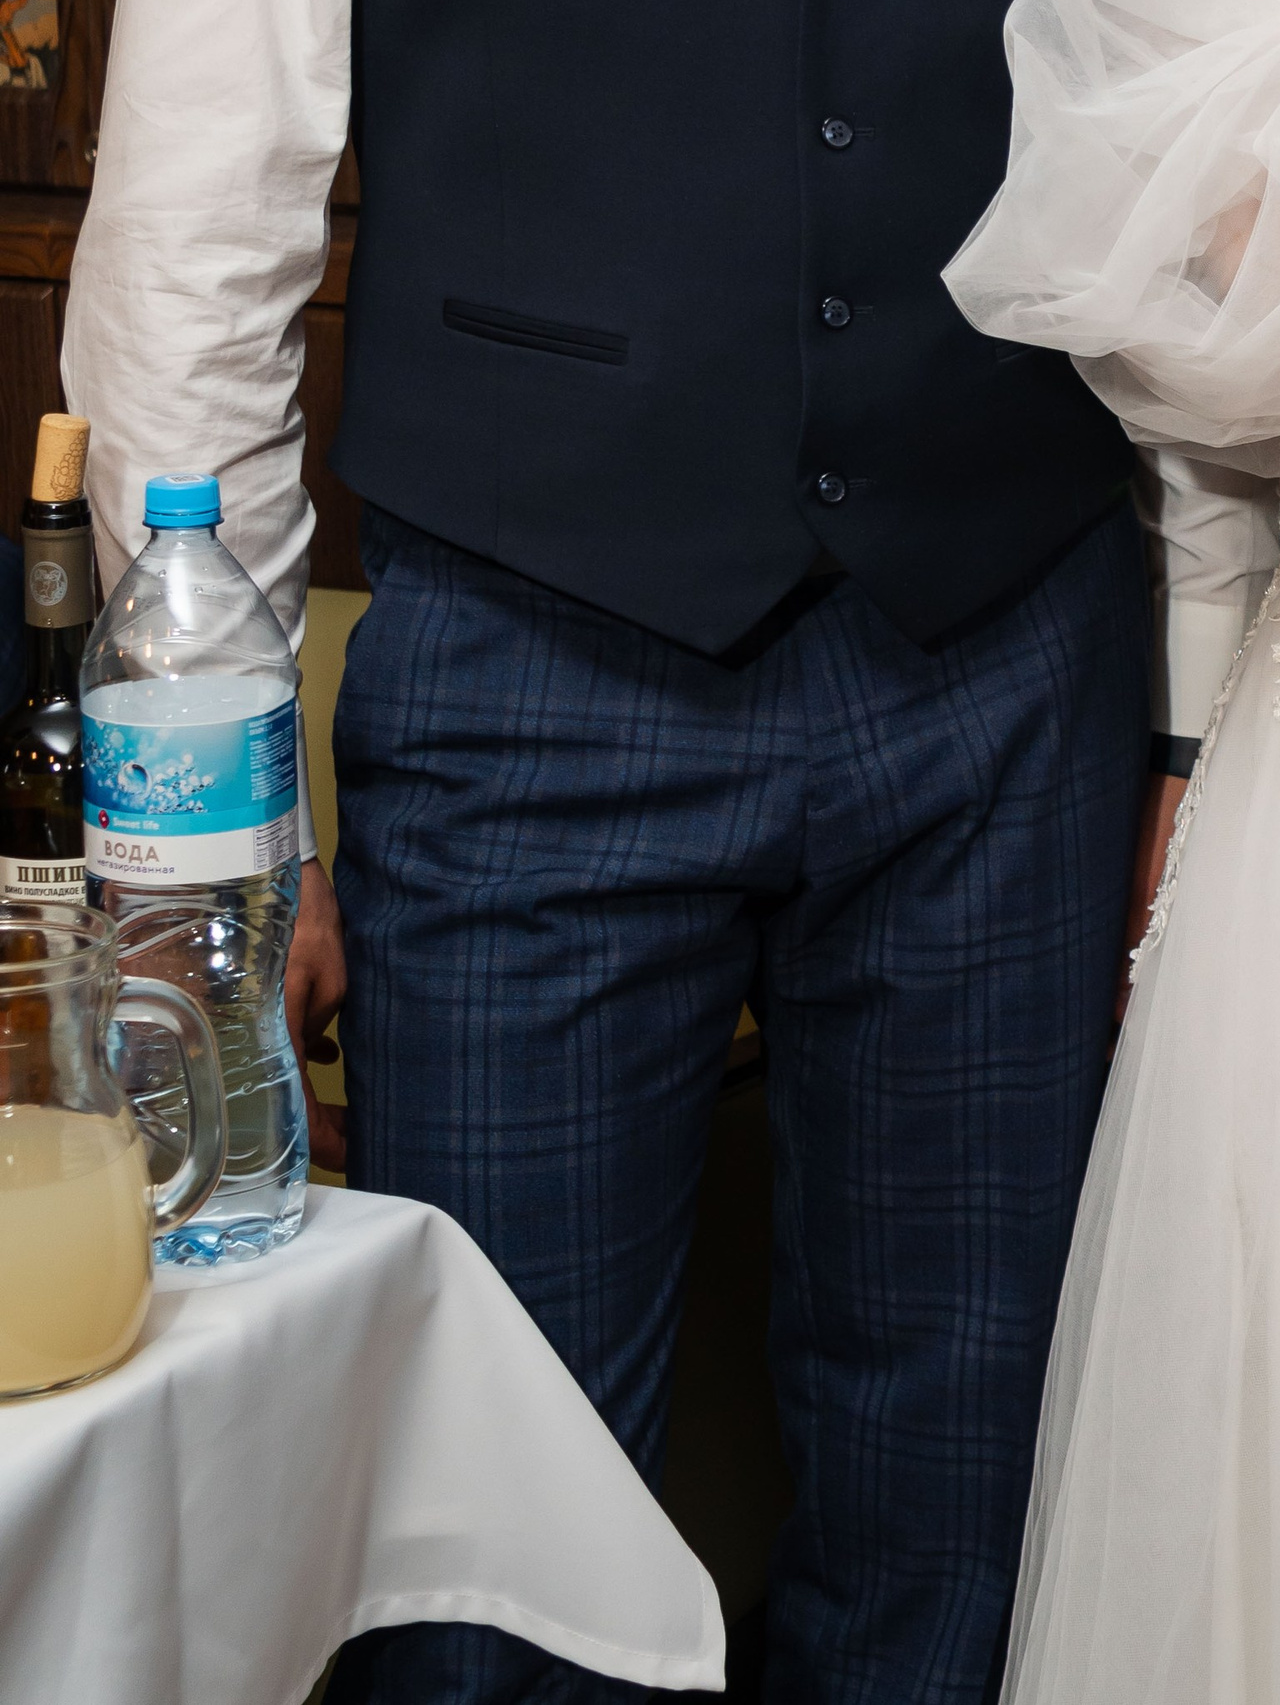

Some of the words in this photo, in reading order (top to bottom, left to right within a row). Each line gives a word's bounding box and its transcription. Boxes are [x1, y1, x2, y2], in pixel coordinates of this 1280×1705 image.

[104, 840, 159, 864] ВОДА
[97, 859, 175, 874] негазированная
[4, 885, 23, 895] ВИНО
[24, 886, 80, 897] ПОЛУСЛАДКОЕ
